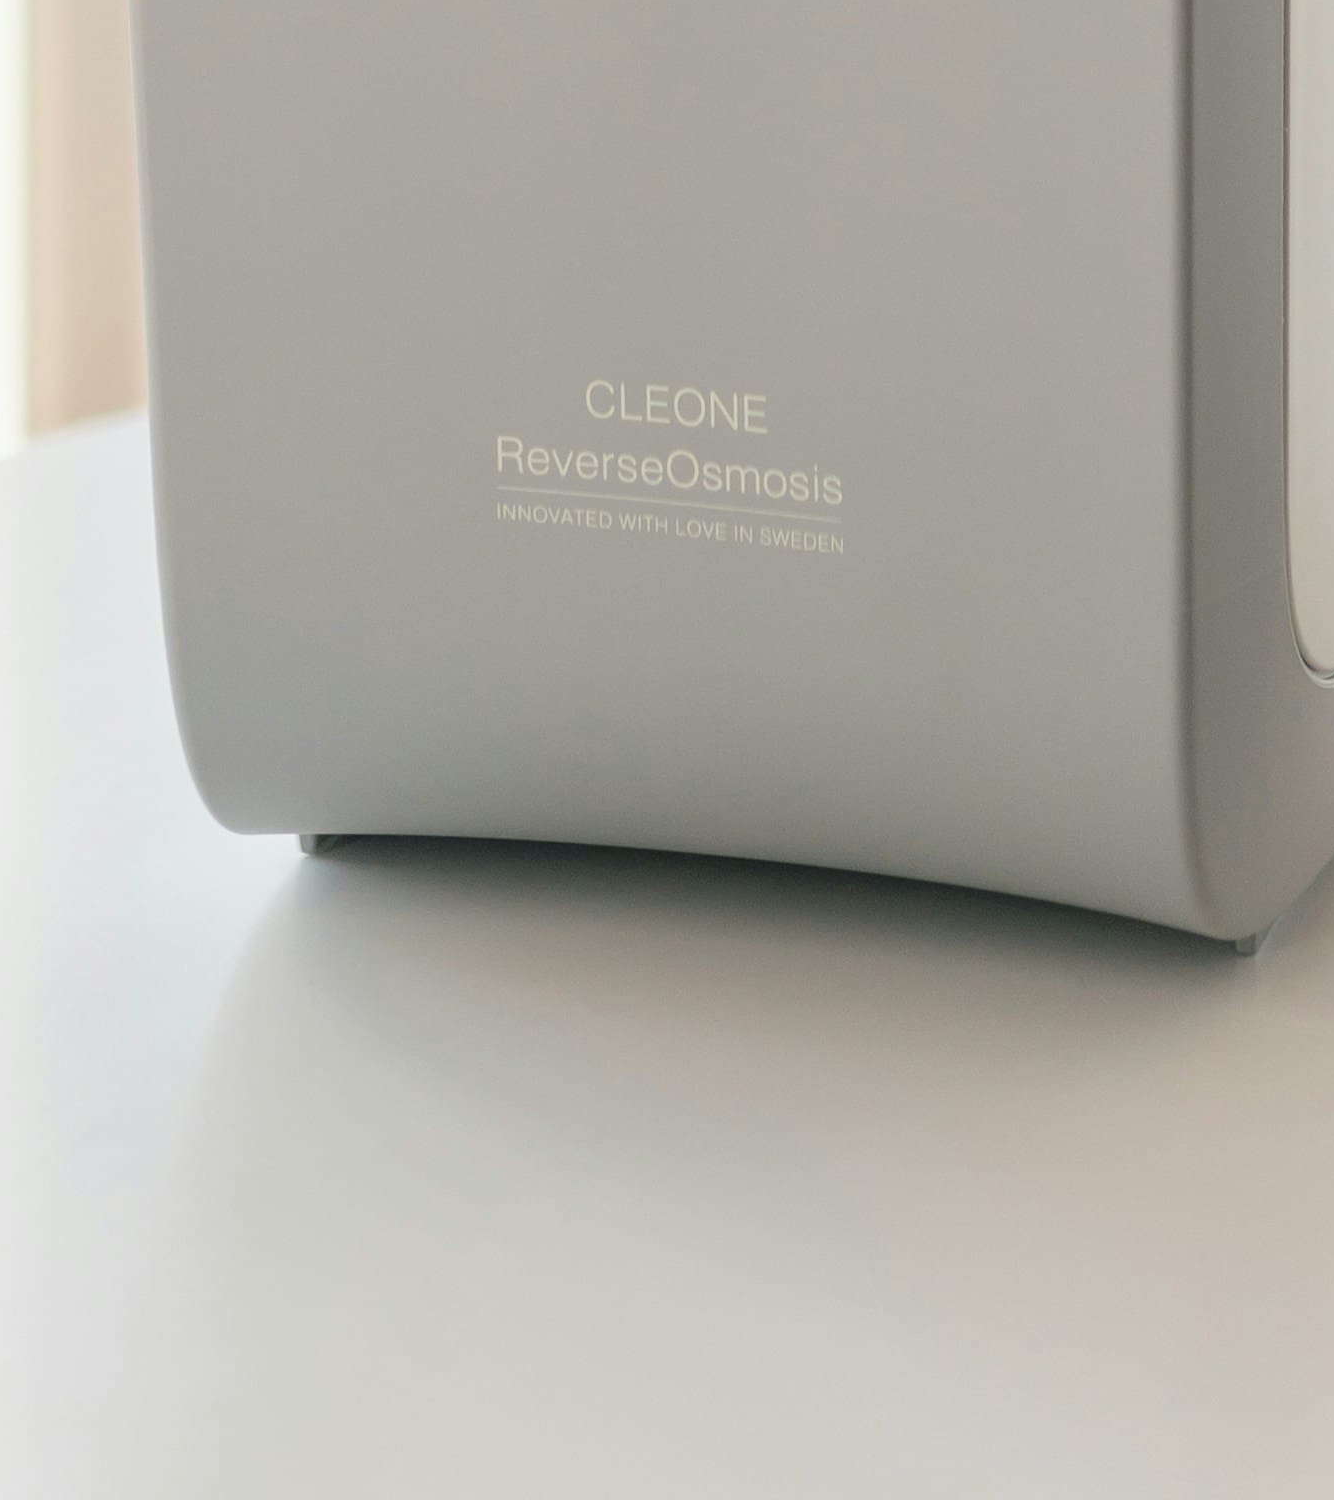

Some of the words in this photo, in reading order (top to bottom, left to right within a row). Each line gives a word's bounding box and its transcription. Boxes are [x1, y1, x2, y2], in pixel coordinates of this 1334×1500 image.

[585, 379, 768, 434] CLEONE
[496, 435, 843, 505] ReverseOsmosis
[496, 503, 612, 530] INNOVATED
[618, 513, 668, 535] WITH
[675, 518, 726, 541] LOVE
[733, 526, 753, 544] IN
[760, 526, 844, 554] SWEDEN
